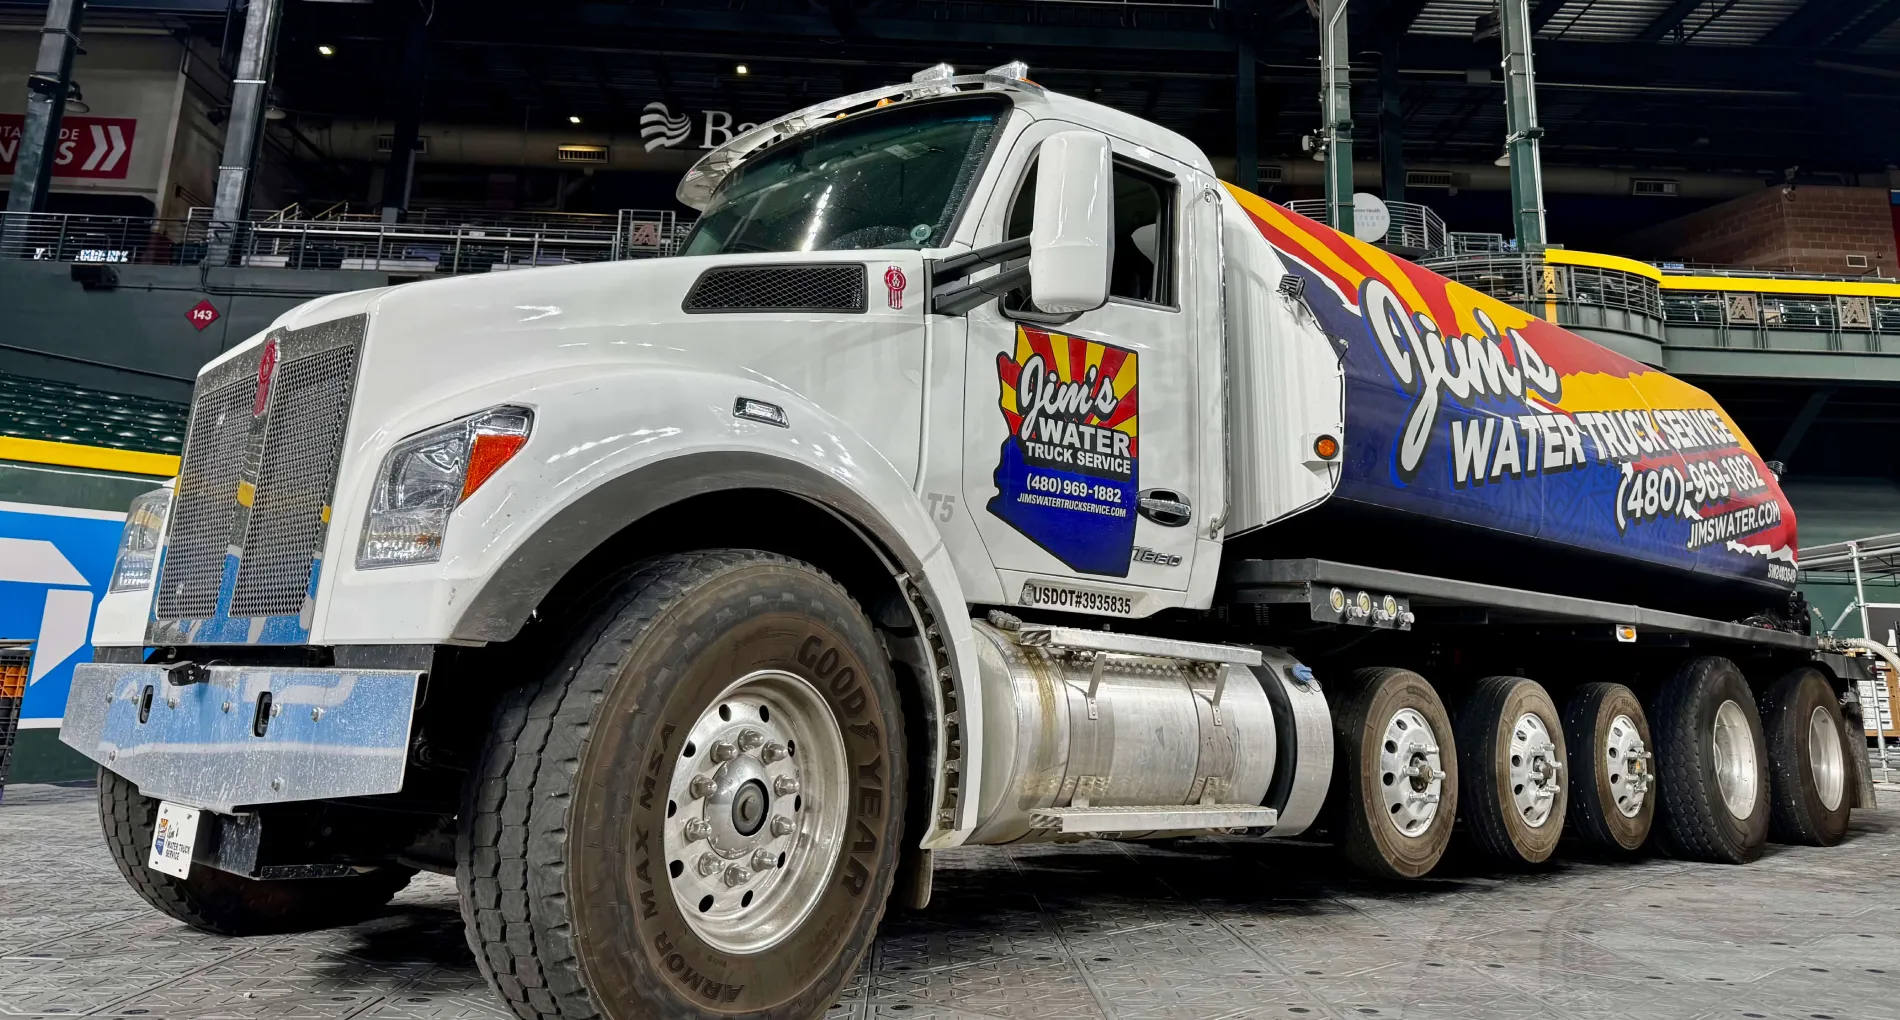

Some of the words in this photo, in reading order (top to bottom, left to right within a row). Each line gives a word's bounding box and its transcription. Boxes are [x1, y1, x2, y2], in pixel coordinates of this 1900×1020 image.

[193, 309, 213, 320] 143
[1021, 355, 1117, 440] Jim's
[1366, 280, 1558, 471] Jim's
[1025, 441, 1073, 464] TRUCK
[1077, 450, 1131, 474] SERVICE
[1038, 416, 1130, 457] WATER
[1452, 414, 1586, 482] WATER
[1575, 411, 1669, 460] TRUCK
[1653, 410, 1738, 450] SERVICE
[928, 492, 955, 522] T5
[1017, 492, 1127, 518] JIMSWATERTRUCKSERVICE.COM
[1027, 473, 1061, 494] (480)
[1063, 480, 1122, 503] 969-1882
[1616, 455, 1766, 530] (480)-969-1882
[1687, 501, 1781, 549] JIMSWATER.COM
[1034, 586, 1131, 614] USDOT#3935835
[640, 723, 676, 811] MSA
[636, 823, 659, 921] MAX
[654, 930, 745, 1002] ARMOR
